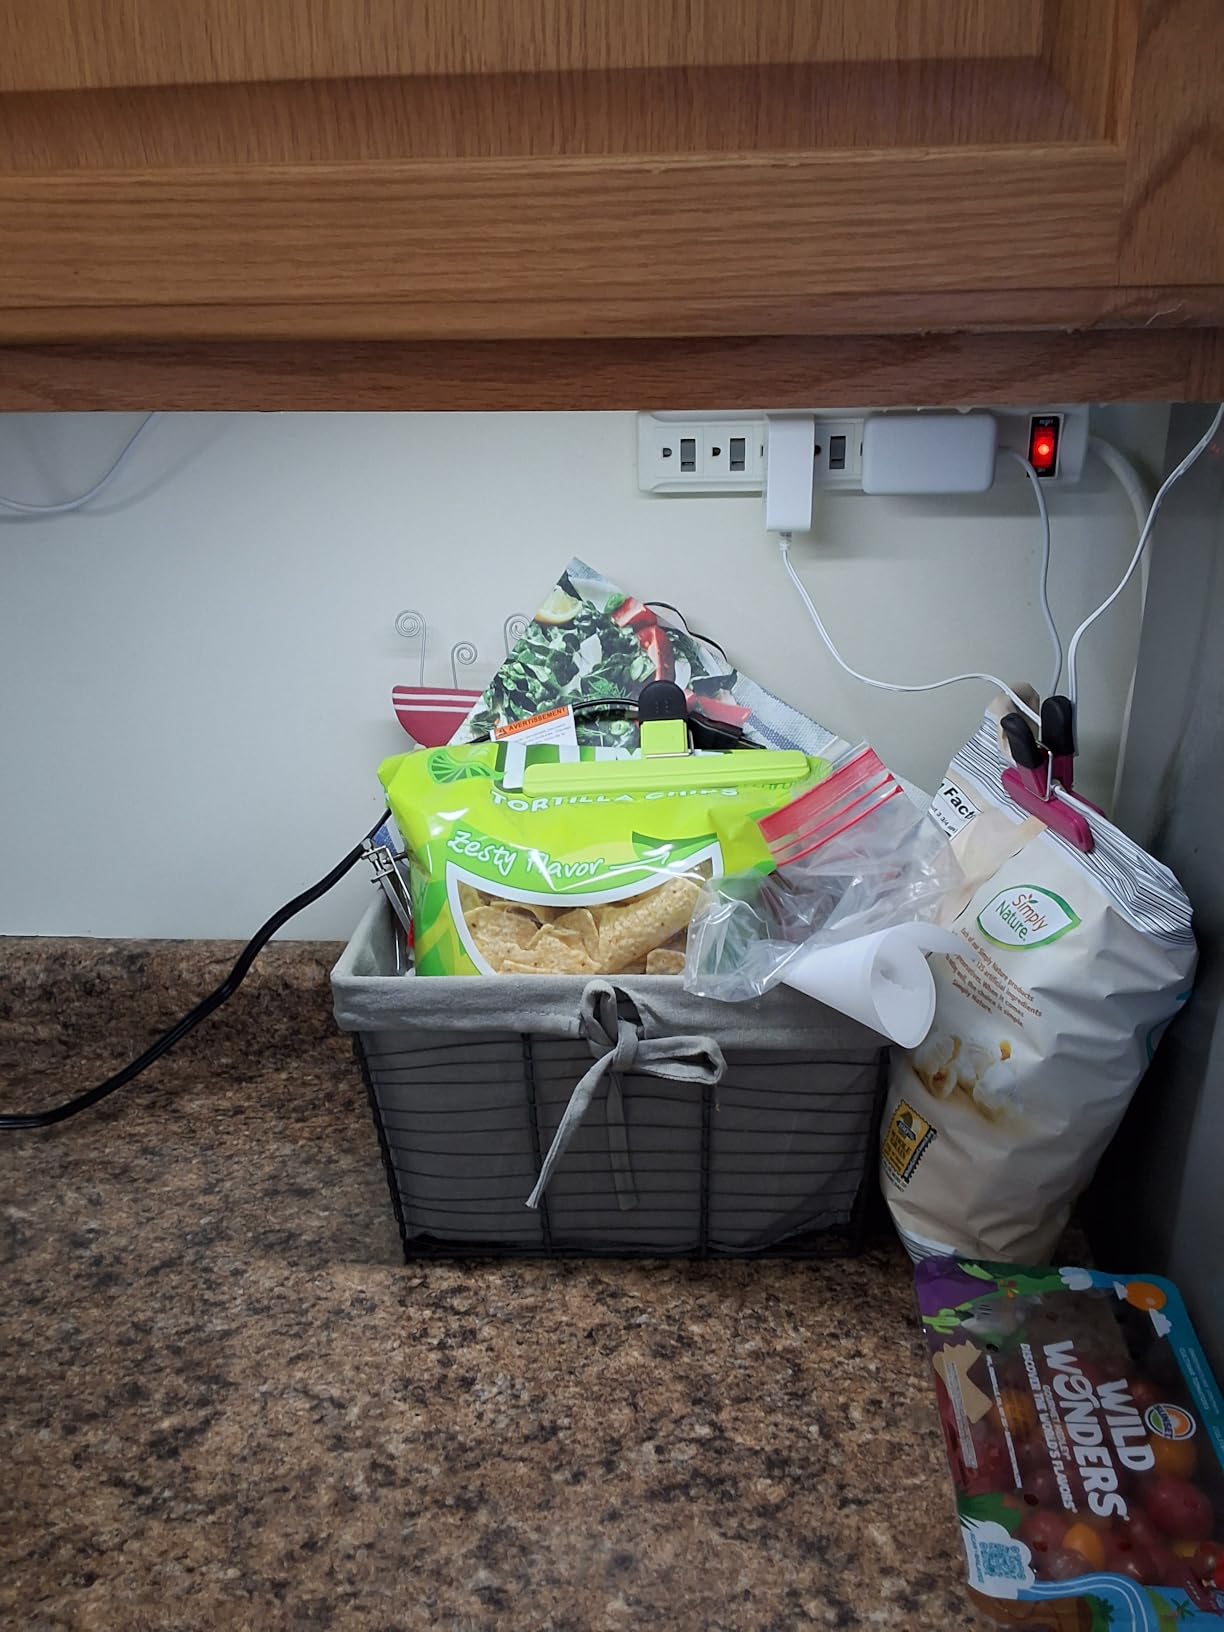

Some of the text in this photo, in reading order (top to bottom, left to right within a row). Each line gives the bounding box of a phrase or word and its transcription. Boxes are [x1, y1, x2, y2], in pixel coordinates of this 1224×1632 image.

[508, 707, 567, 731] AVERTISSEMENT
[489, 788, 636, 813] TORTILLA
[943, 786, 976, 820] Fact
[447, 829, 518, 877] Zesty
[1011, 893, 1049, 932] Simply
[1005, 990, 1042, 1017] ingredients
[1007, 979, 1034, 1002] products
[1020, 1343, 1042, 1390] DISCOVER
[1033, 1389, 1047, 1414] THE
[1043, 1340, 1128, 1518] WONDERS
[1096, 1377, 1156, 1472] WILD
